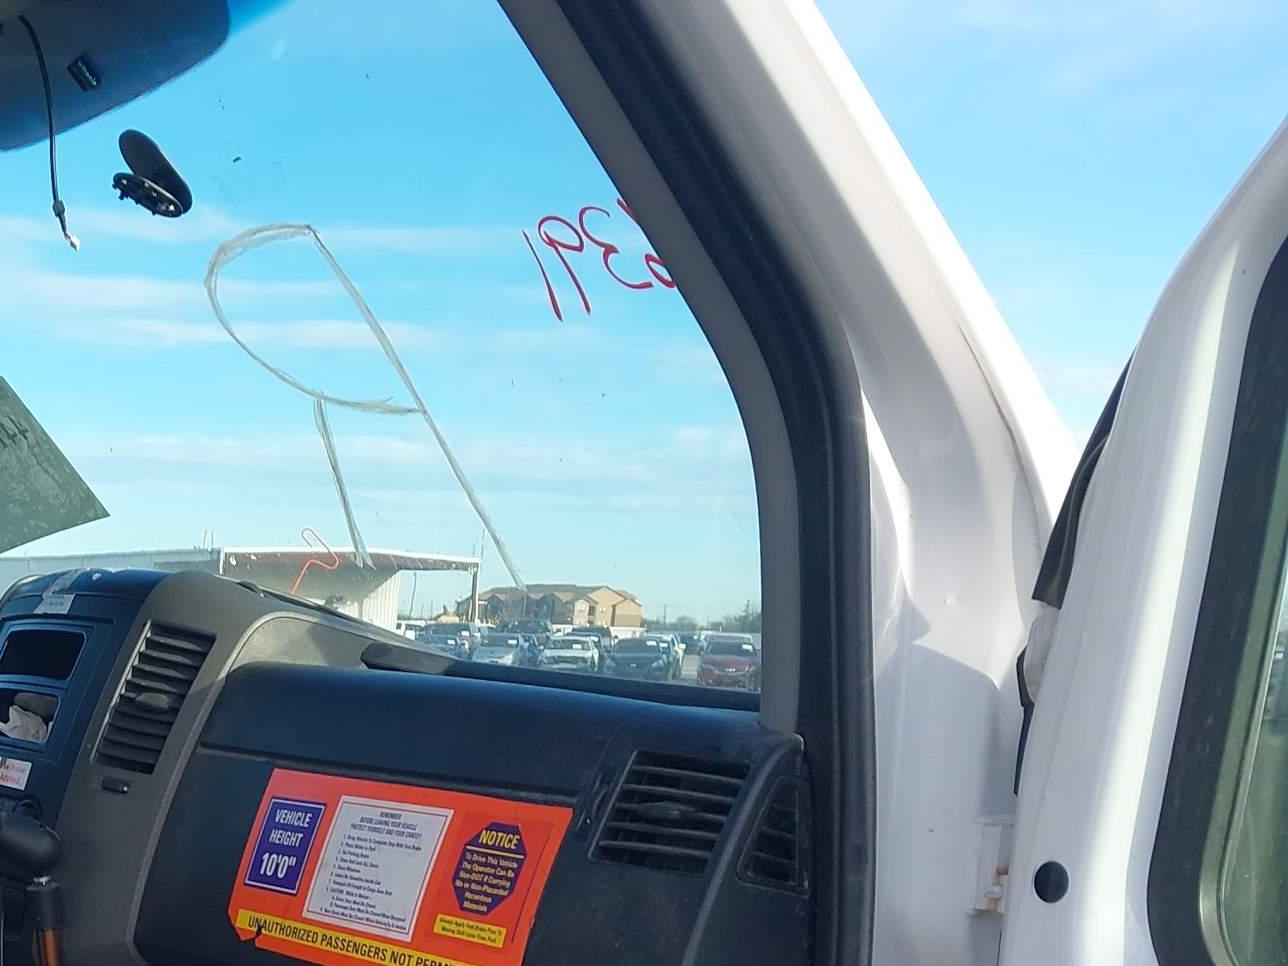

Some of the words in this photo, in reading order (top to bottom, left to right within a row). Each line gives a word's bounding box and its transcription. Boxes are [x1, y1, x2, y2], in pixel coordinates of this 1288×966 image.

[275, 808, 313, 828] VEHICLE
[269, 828, 304, 848] HEIGHT
[479, 829, 520, 849] NOTICE
[248, 915, 319, 945] UNAUTHORIZED
[320, 933, 388, 961] PASSENGERS
